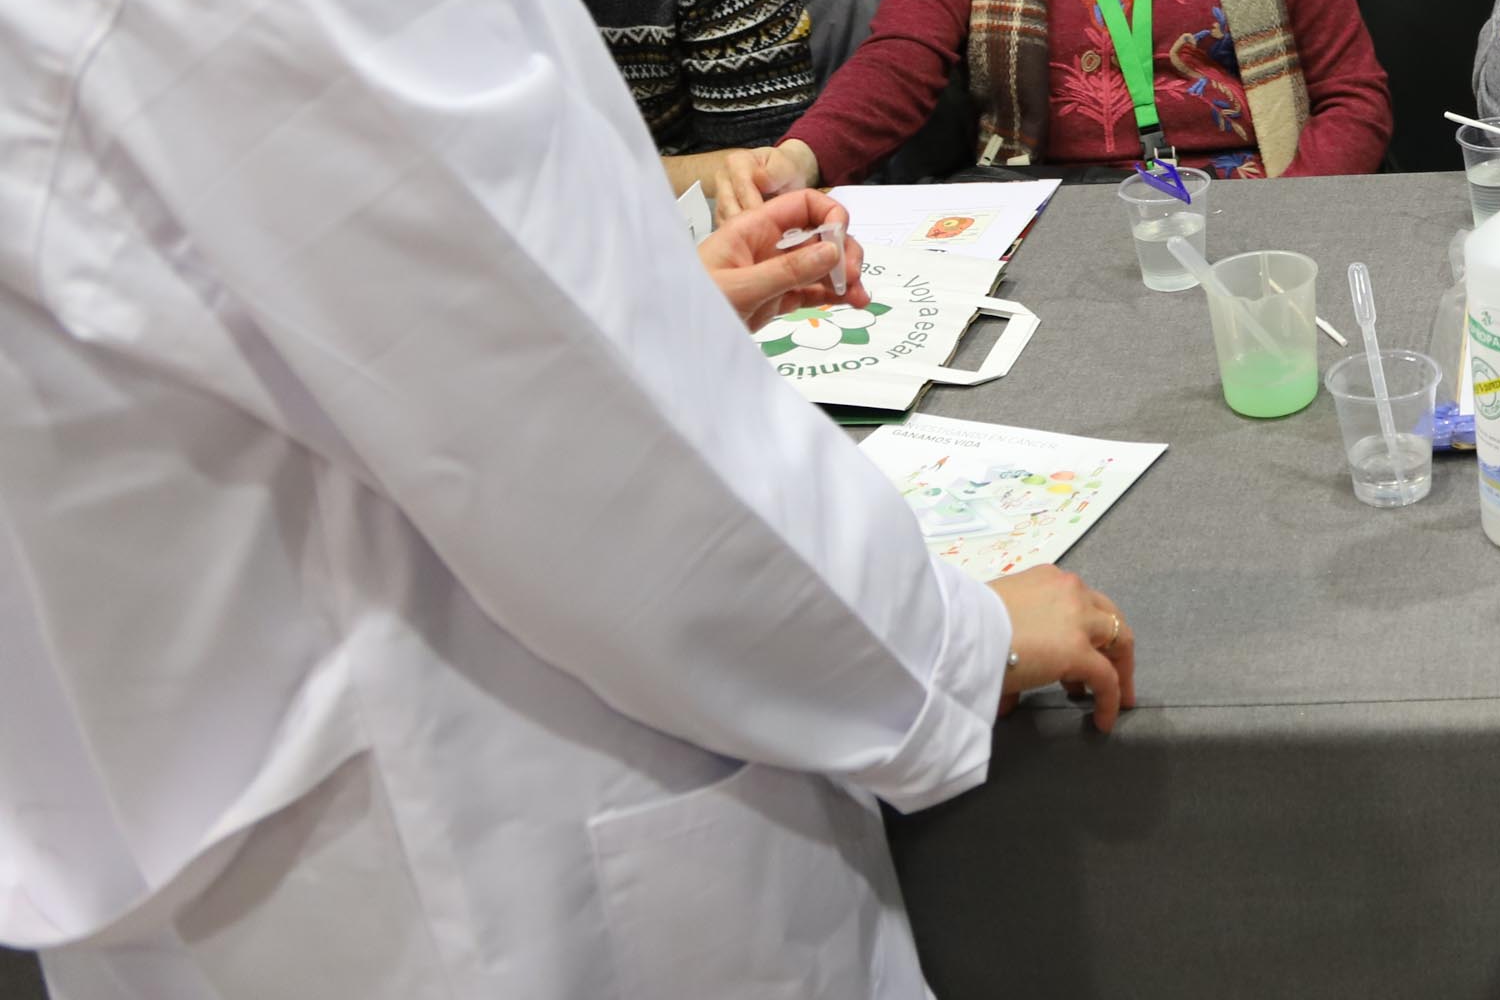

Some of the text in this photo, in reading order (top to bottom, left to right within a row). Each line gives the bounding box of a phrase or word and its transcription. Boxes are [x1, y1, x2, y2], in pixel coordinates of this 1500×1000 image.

[903, 275, 936, 304] Voy
[919, 307, 939, 317] a
[885, 318, 935, 359] estar
[777, 356, 880, 380] contig
[891, 429, 981, 449] GANAMOS VIDA
